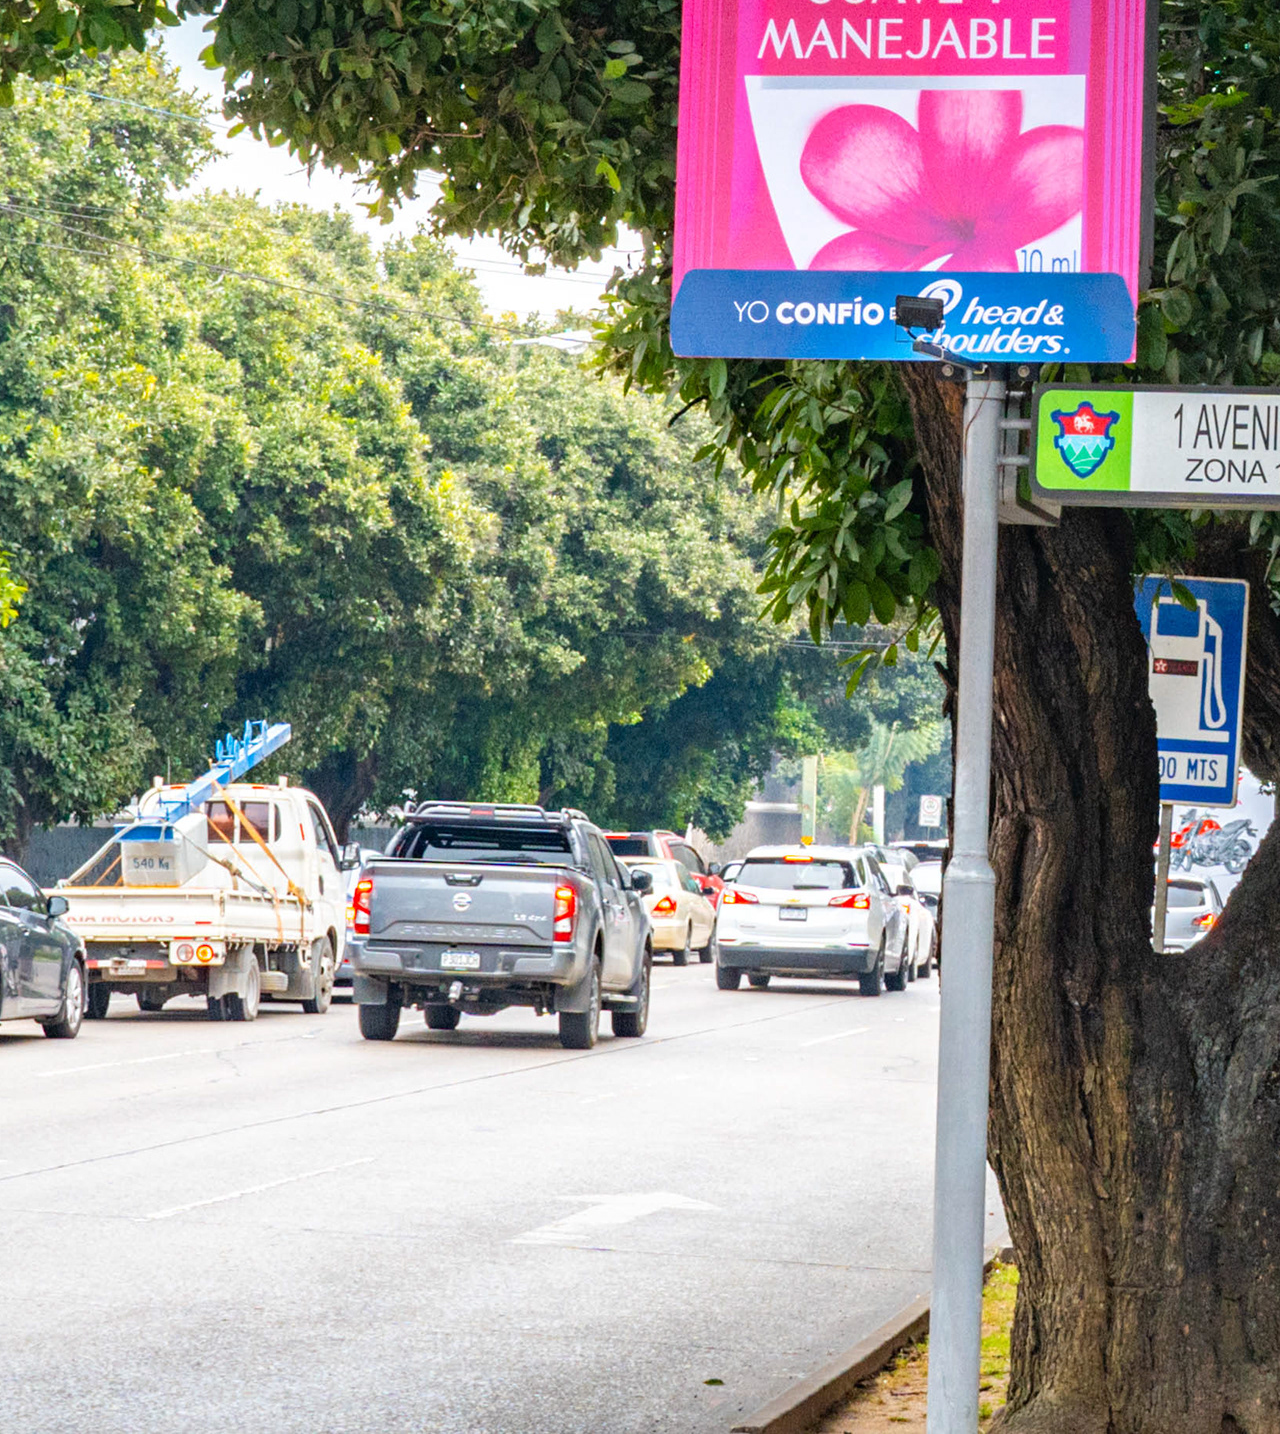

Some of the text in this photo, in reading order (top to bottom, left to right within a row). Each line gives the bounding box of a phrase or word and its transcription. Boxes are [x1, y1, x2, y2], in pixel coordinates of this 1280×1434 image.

[757, 18, 1057, 61] MANEJABLE
[1020, 249, 1043, 273] 10
[733, 301, 770, 324] YO
[775, 296, 885, 326] CONFÍO
[1173, 405, 1185, 449] 1
[1184, 458, 1267, 485] ZONA
[1186, 758, 1218, 782] MTS
[133, 857, 155, 869] 540
